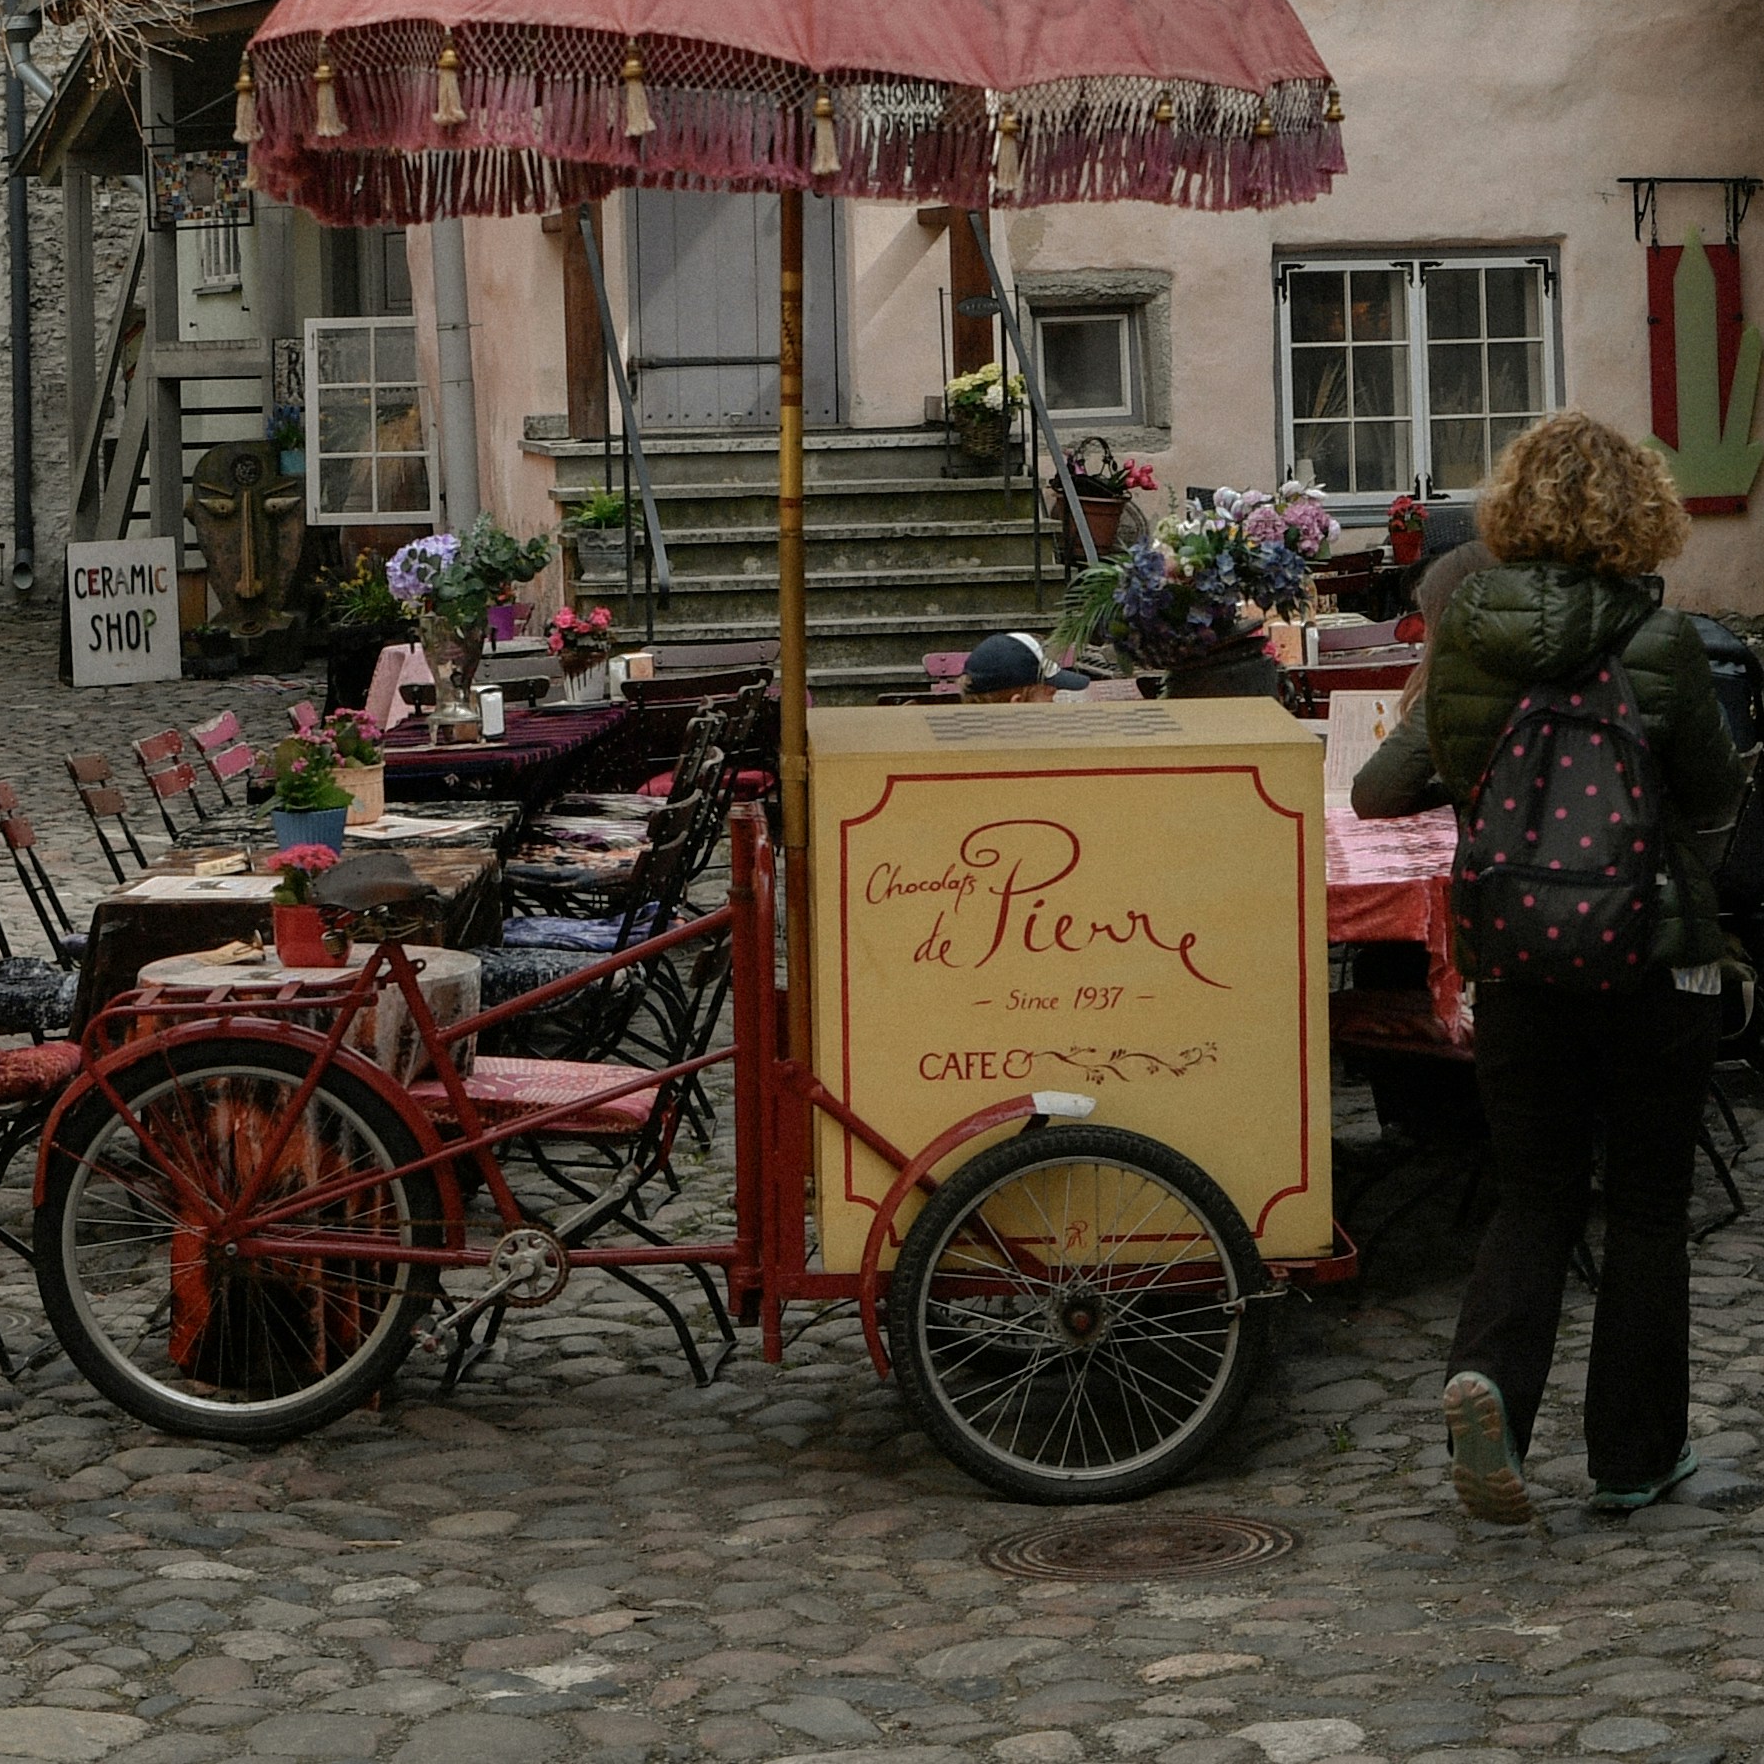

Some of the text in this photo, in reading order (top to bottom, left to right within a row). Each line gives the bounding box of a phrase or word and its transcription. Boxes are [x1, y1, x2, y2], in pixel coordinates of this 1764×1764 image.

[74, 564, 168, 599] CERAMIC
[89, 608, 158, 653] SHOP
[866, 862, 977, 913] Chocolats
[913, 819, 1232, 989] de Pierre
[1006, 986, 1124, 1010] Since 1937
[919, 1052, 998, 1081] CAFE
